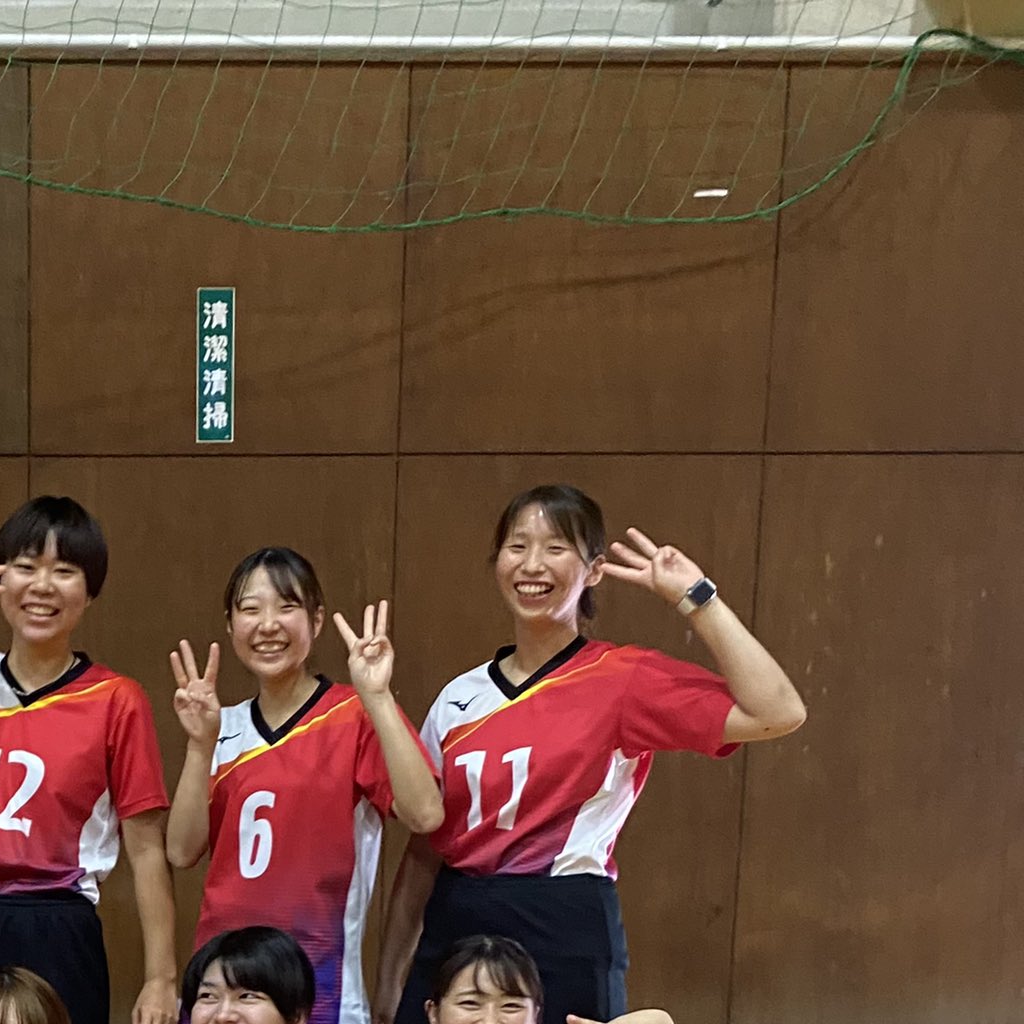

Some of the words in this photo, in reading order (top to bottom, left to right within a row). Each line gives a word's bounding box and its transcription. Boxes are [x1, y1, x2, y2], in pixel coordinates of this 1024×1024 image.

[202, 300, 229, 430] 清潔清掃
[453, 746, 532, 830] 11
[238, 790, 276, 879] 6
